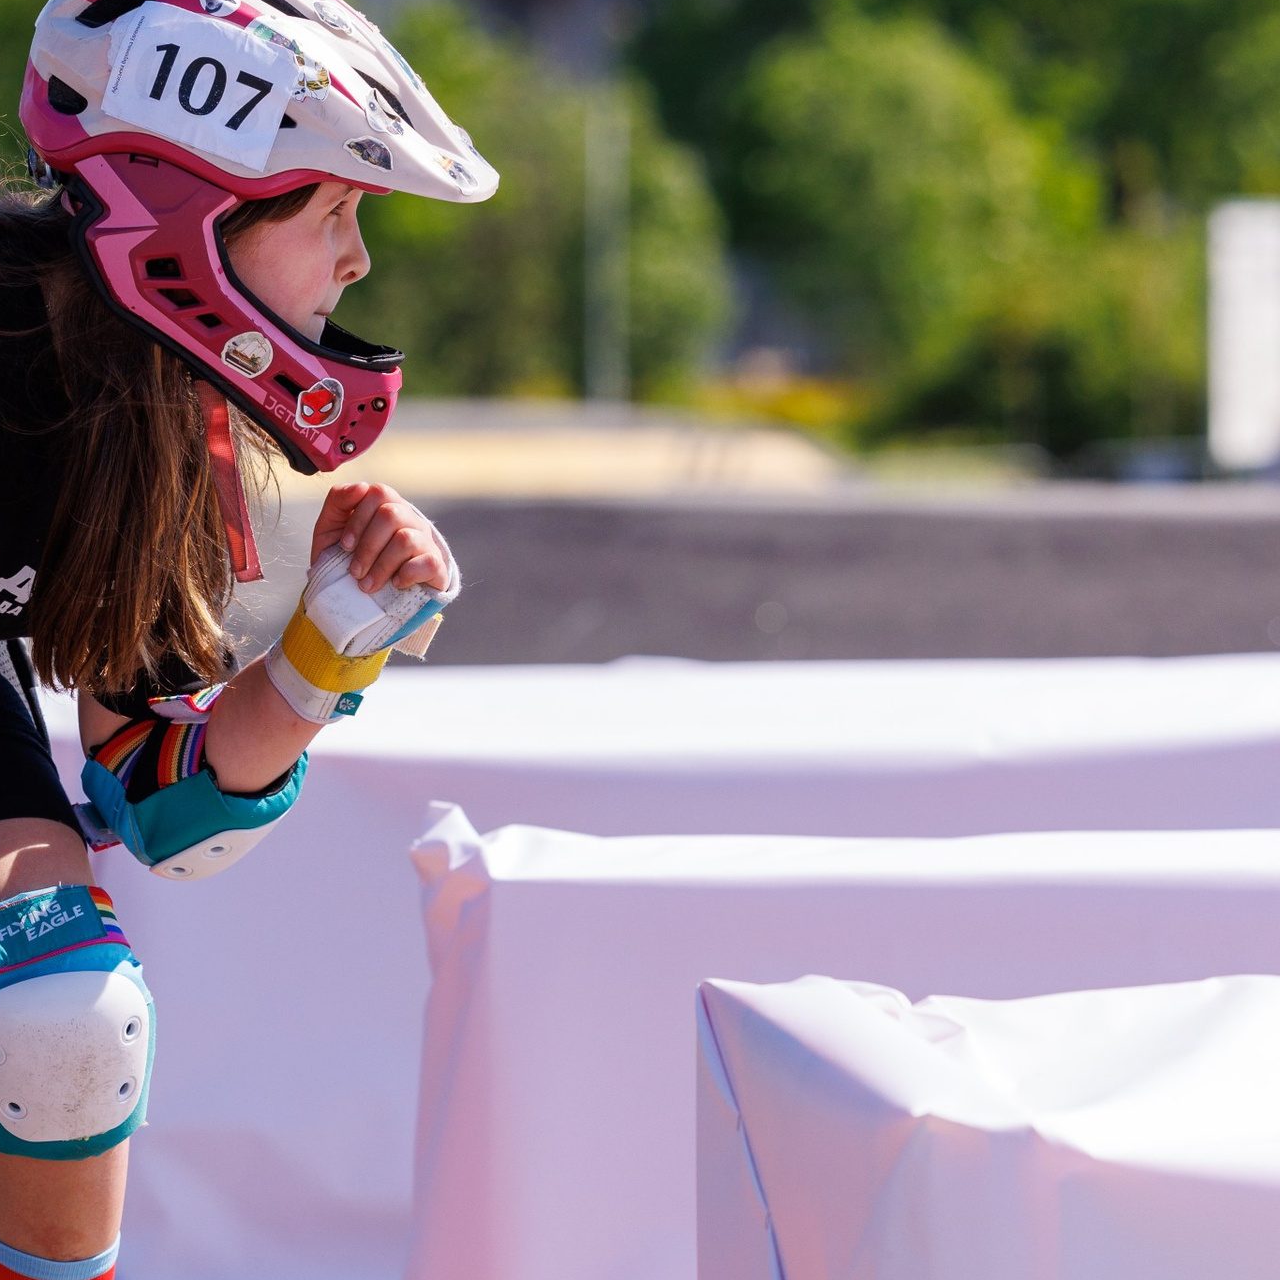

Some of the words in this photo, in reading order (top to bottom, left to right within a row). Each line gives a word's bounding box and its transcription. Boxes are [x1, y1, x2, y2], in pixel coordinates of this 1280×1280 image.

[149, 43, 274, 131] 107
[265, 395, 320, 441] JETCAT
[25, 904, 85, 942] EAGLE
